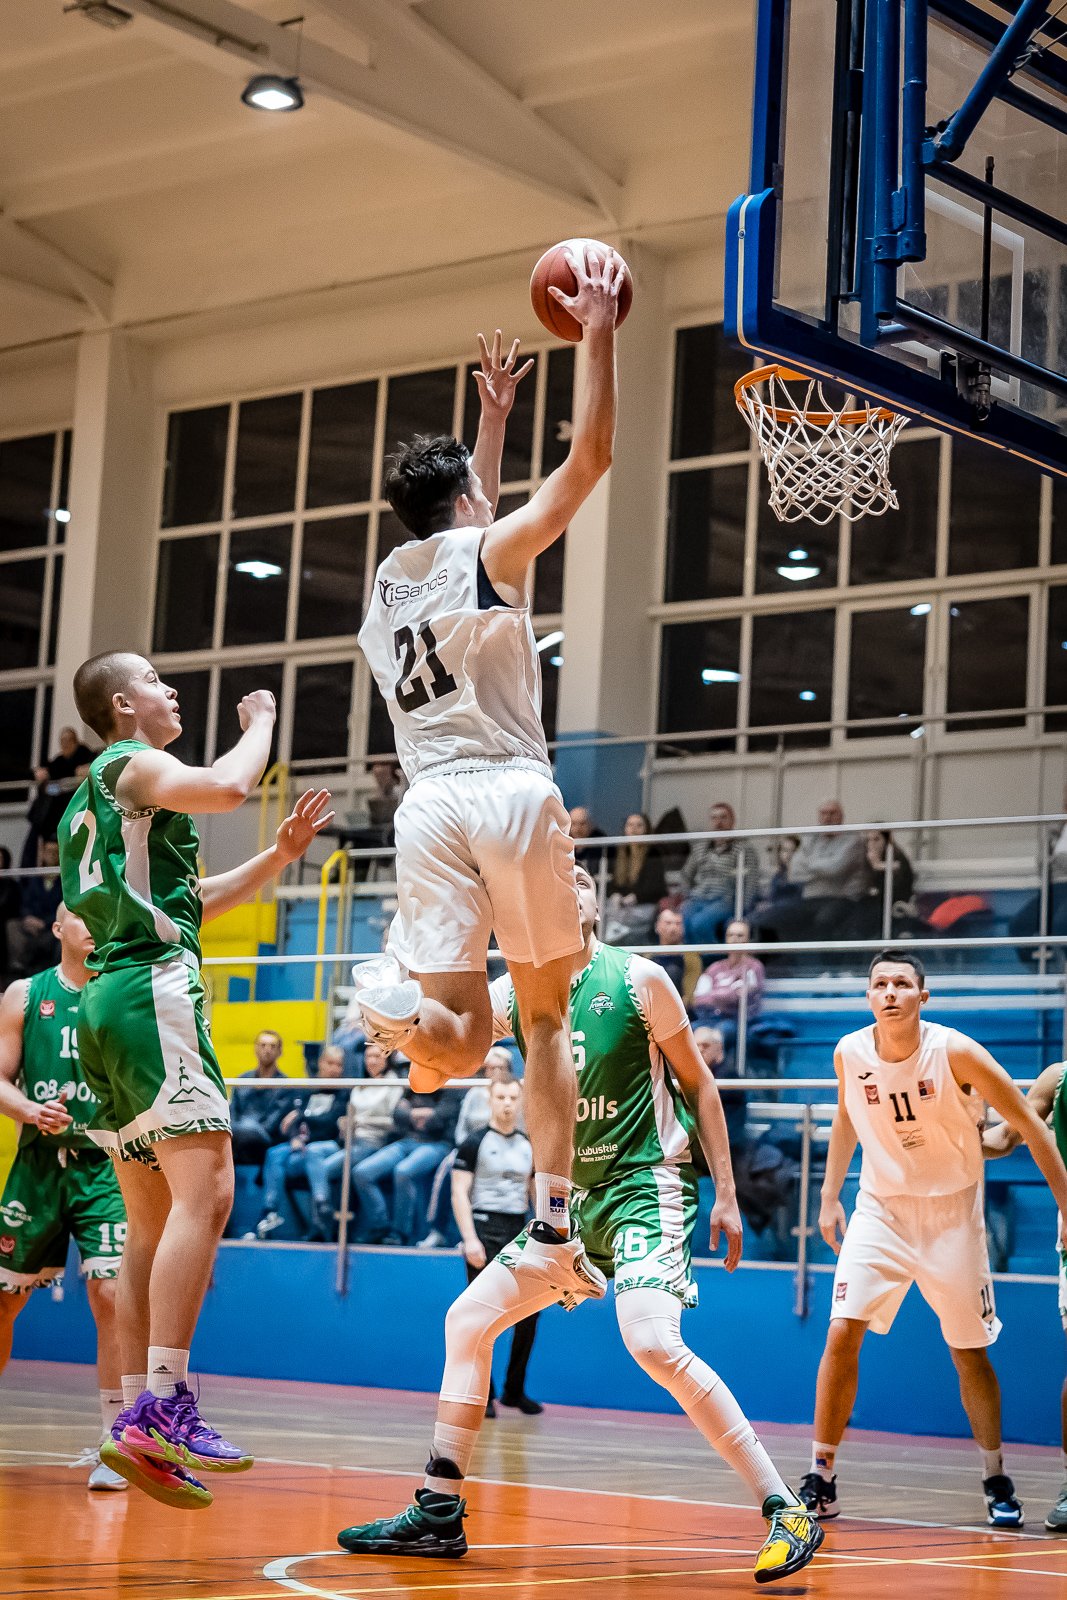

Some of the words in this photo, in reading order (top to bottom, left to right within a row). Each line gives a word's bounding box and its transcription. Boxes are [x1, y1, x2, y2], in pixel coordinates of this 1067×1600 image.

[394, 619, 458, 713] 21
[70, 808, 104, 895] 2
[576, 1095, 619, 1122] Oils
[889, 1091, 916, 1122] 11
[577, 1142, 619, 1157] Lubuskie
[98, 1221, 128, 1254] 19
